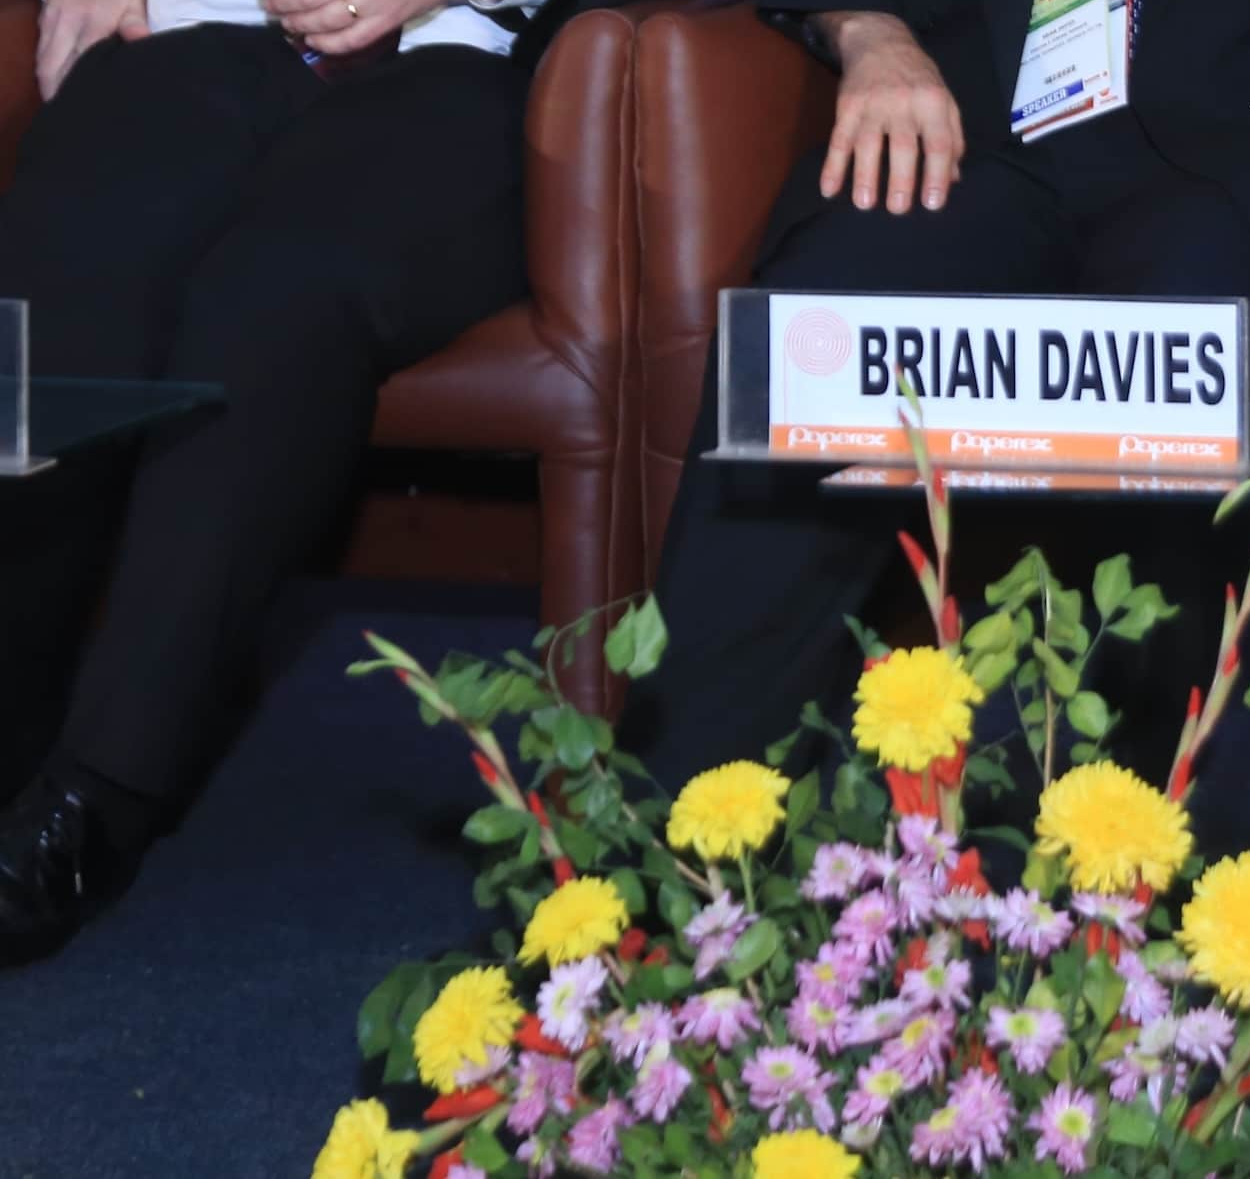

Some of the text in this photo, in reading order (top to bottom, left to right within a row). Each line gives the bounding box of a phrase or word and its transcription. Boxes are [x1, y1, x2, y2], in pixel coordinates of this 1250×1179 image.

[1021, 86, 1067, 117] SPEAKER
[858, 324, 1017, 400] BRIAN
[1037, 328, 1227, 406] DAVIES
[787, 426, 1223, 461] Paperex Paperex Paperex
